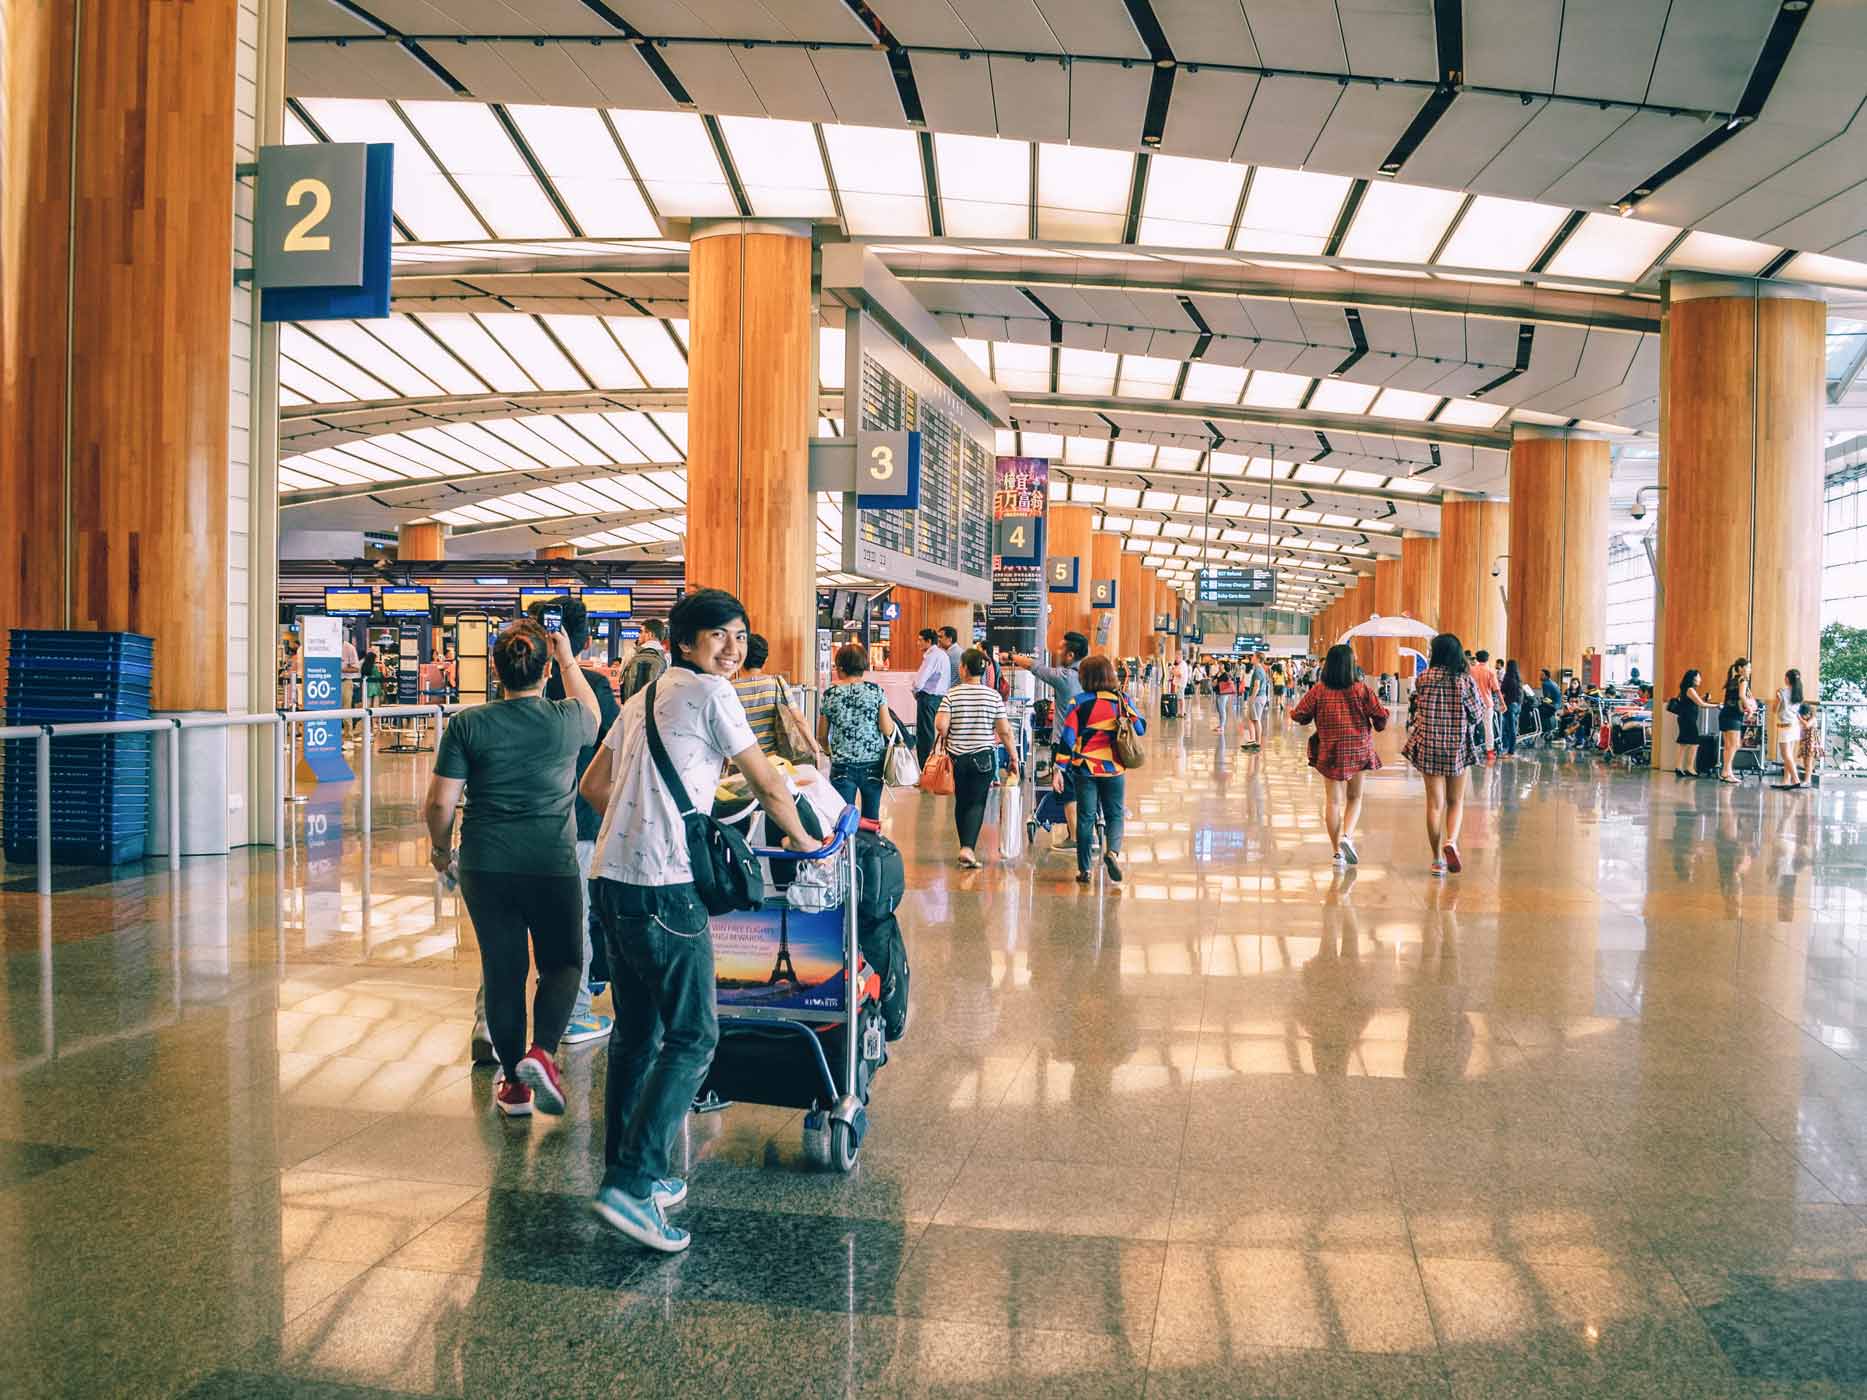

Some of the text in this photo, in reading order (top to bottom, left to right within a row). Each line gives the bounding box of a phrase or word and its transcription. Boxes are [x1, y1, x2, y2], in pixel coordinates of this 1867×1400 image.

[284, 178, 332, 251] 2
[870, 446, 895, 479] 3
[1009, 525, 1025, 548] 4
[1055, 563, 1067, 580] 5
[1096, 584, 1107, 599] 6
[886, 604, 898, 618] 4
[306, 680, 331, 699] 60
[306, 727, 328, 747] 10
